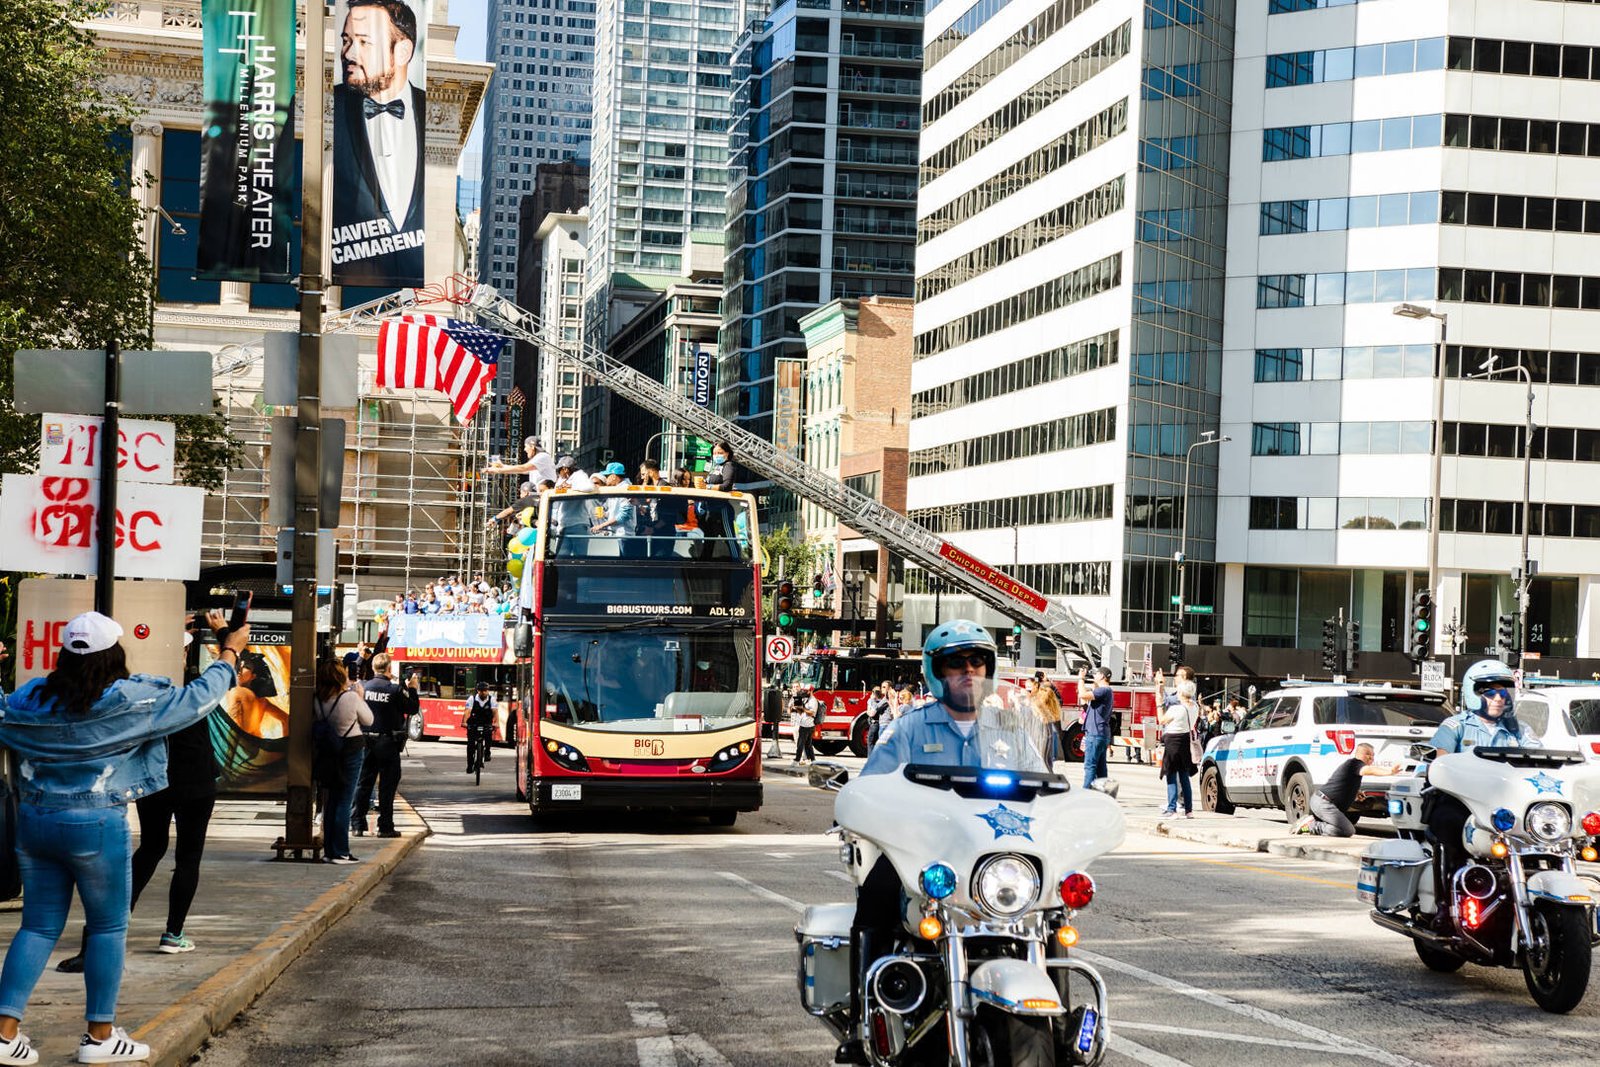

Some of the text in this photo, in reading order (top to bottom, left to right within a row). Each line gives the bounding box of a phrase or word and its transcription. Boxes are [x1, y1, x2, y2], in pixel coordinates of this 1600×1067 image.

[237, 68, 250, 202] MILLENNIUM PARK
[251, 45, 276, 249] HARRIS THEATER
[332, 218, 391, 245] JAVIER
[332, 229, 425, 265] CAMARENA
[697, 355, 708, 403] ROSS
[948, 549, 986, 576] CHICAGO
[988, 571, 1009, 590] FIRE
[607, 605, 745, 617] BIGBUSTOURS.COM ADL 129
[1530, 633, 1543, 642] 24
[1531, 623, 1543, 632] 41
[365, 690, 390, 703] POLICE
[634, 739, 650, 748] BIG
[634, 748, 650, 756] BUS
